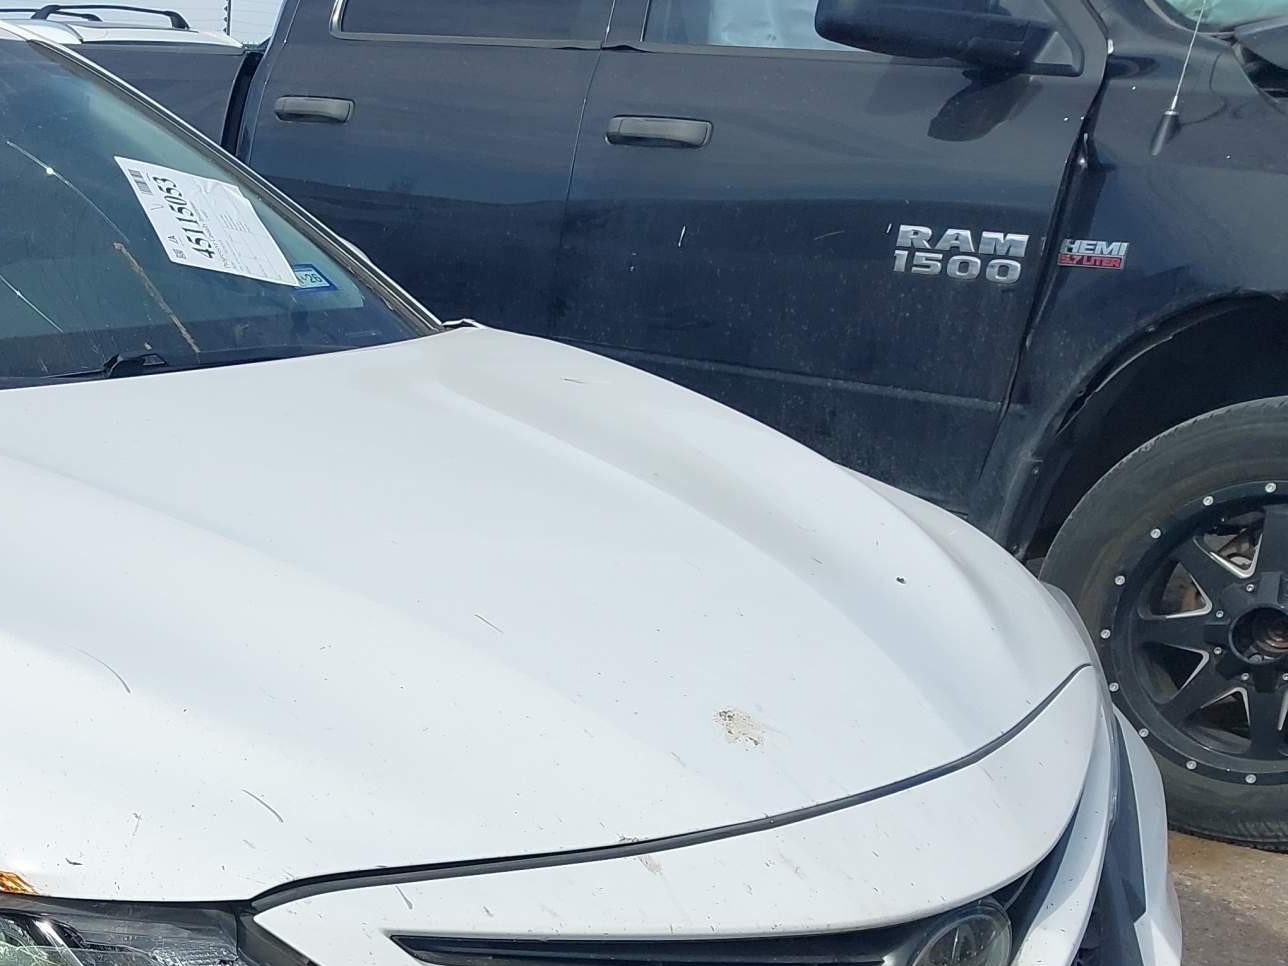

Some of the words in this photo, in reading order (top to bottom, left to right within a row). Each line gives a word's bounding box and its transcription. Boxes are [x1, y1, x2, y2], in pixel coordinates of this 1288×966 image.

[152, 177, 216, 259] 45115053
[896, 225, 1030, 257] RAM
[1060, 239, 1129, 256] HEMI
[892, 250, 1022, 283] 1500
[1083, 256, 1121, 267] LITER
